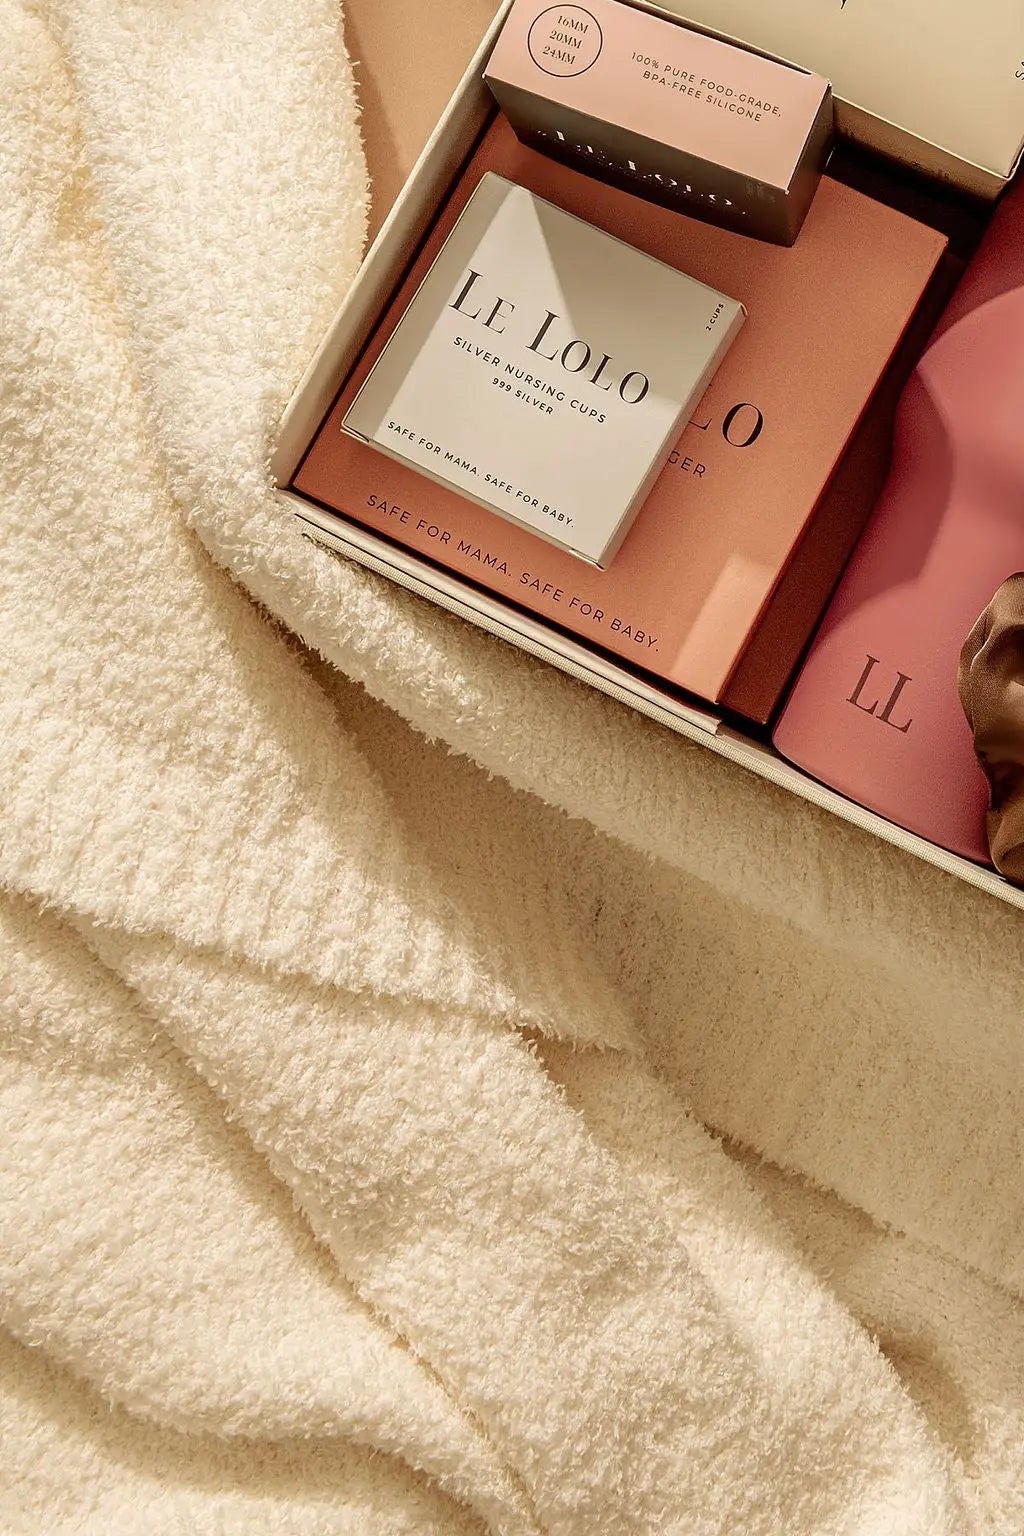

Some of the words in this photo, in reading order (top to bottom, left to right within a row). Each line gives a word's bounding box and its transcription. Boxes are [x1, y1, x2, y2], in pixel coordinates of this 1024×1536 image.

[550, 31, 582, 48] 20MM
[558, 16, 588, 33] 16MM
[543, 47, 575, 64] 24MM
[632, 52, 658, 68] 100%
[664, 65, 695, 82] PURE
[643, 71, 701, 98] BPA-FREE
[706, 95, 761, 121] SILICONE
[710, 304, 724, 324] CUPS
[449, 269, 515, 334] LE
[526, 310, 648, 404] LOLO
[454, 337, 500, 366] SILVER
[505, 364, 565, 401] NURSING
[571, 400, 605, 423] CUPS
[492, 378, 511, 391] 999
[515, 390, 553, 414] SILVER
[388, 422, 415, 440] SAFE
[419, 438, 441, 454] FOR
[445, 452, 479, 476] MAMA.
[485, 474, 512, 493] SAFE
[516, 491, 538, 507] FOR
[542, 505, 573, 527] BABY.
[367, 495, 411, 523] SAFE
[416, 520, 451, 544] FOR
[457, 541, 511, 576] MAMA.
[520, 573, 564, 601] SAFE
[569, 597, 604, 622] FOR
[611, 618, 658, 651] BABY.
[846, 654, 913, 734] LL
